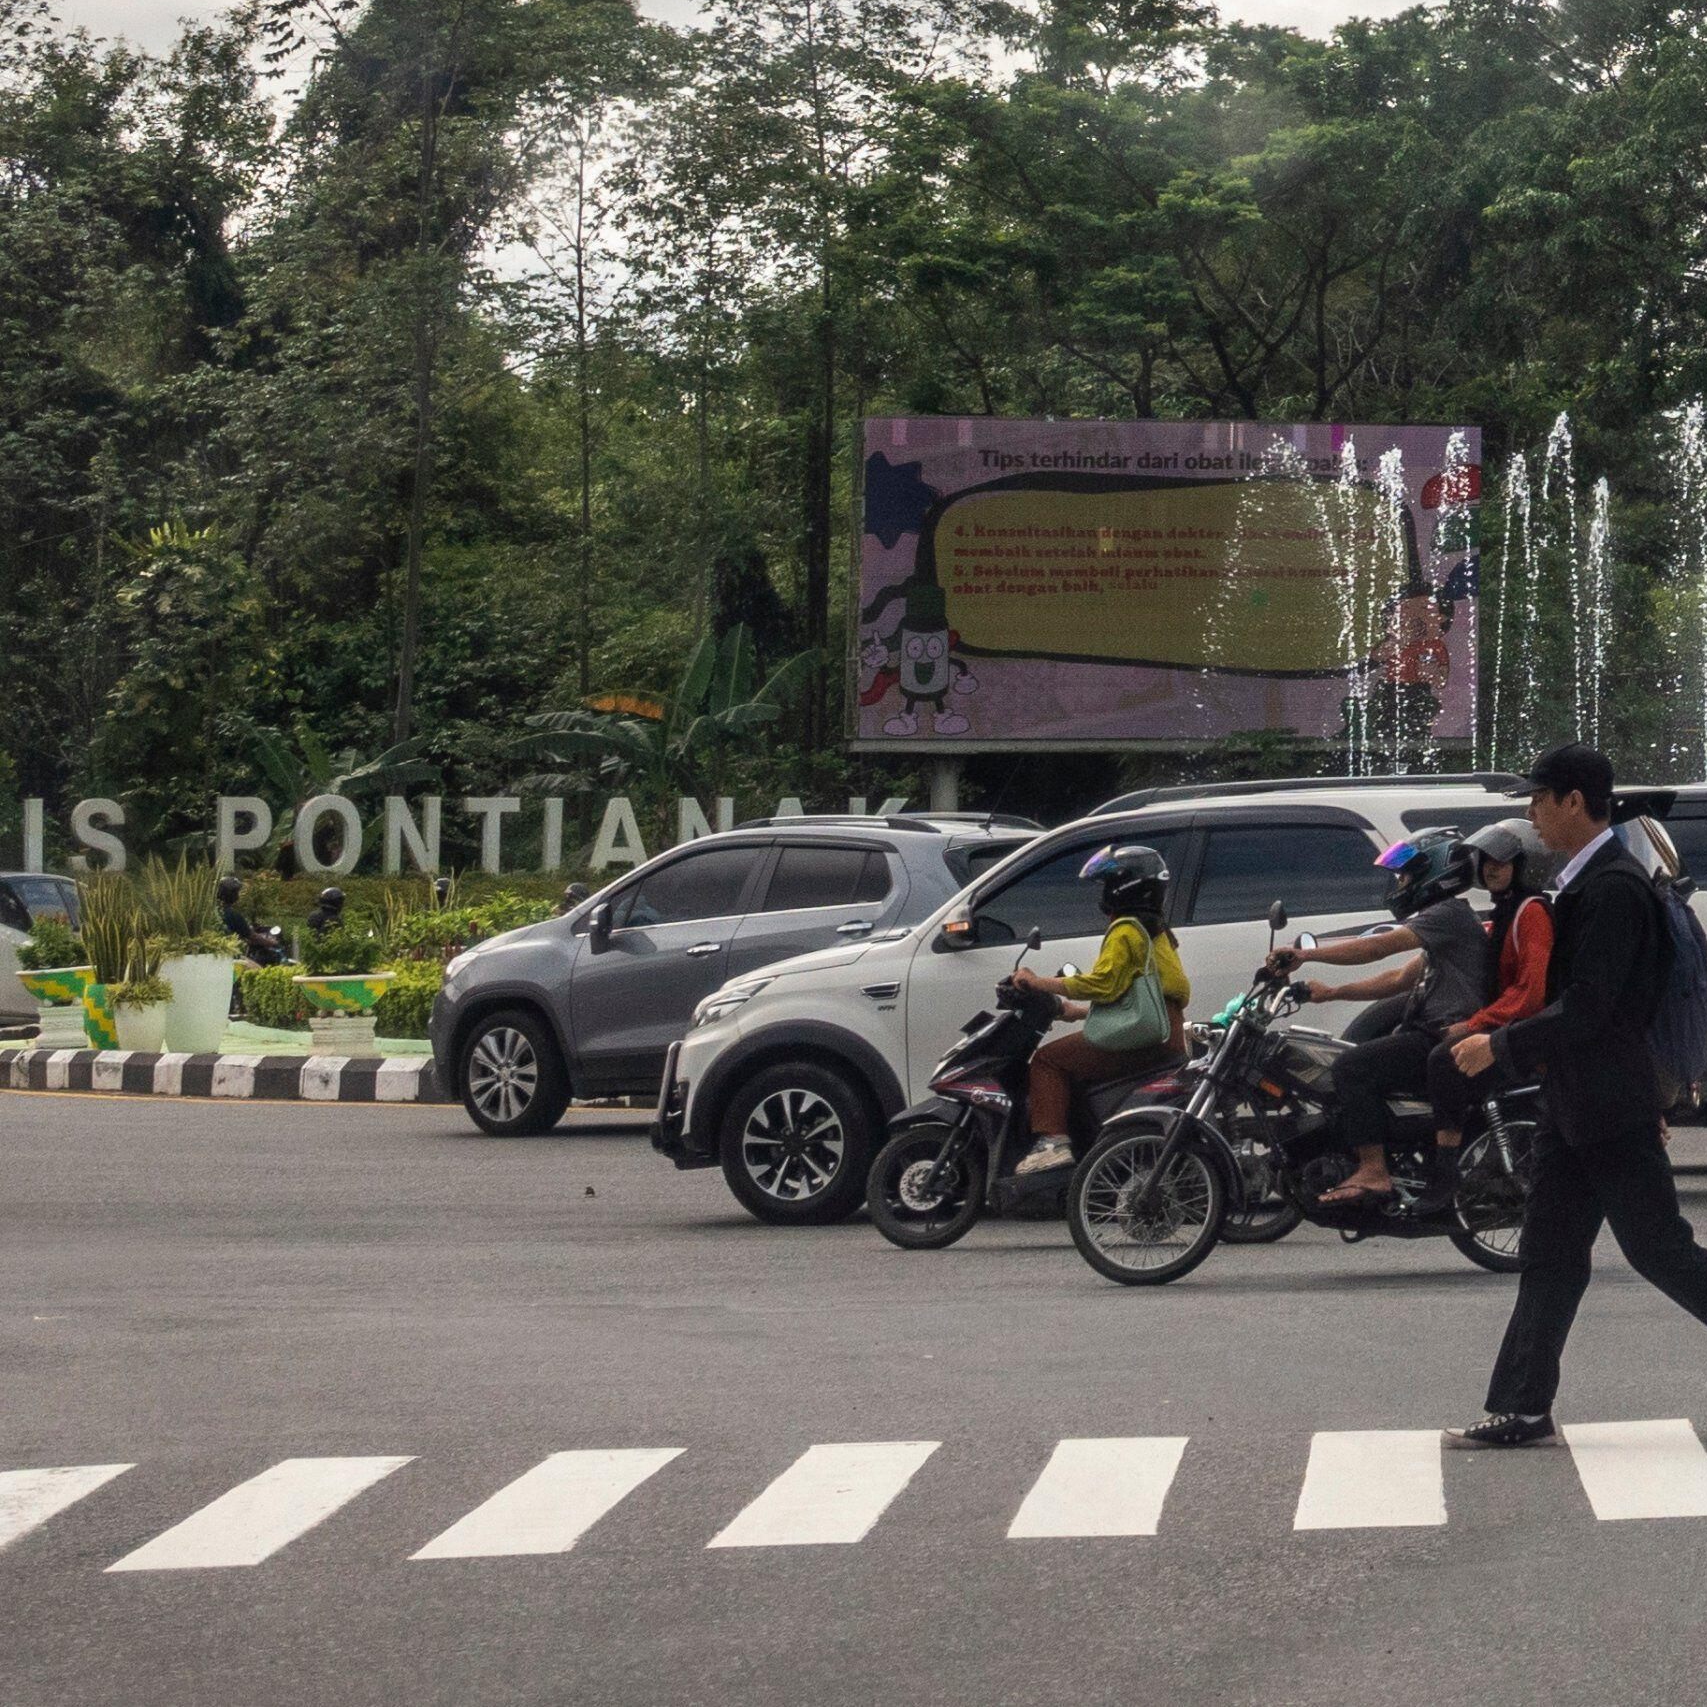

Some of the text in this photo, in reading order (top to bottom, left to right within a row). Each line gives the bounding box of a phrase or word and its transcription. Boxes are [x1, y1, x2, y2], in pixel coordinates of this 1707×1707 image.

[978, 449, 1025, 470] Tips
[1031, 450, 1133, 469] terhindar
[1137, 451, 1179, 469] dari
[1184, 452, 1234, 470] obat
[1101, 525, 1164, 541] dengan
[996, 580, 1058, 596] dengan
[24, 795, 909, 875] IS PONTIAN
